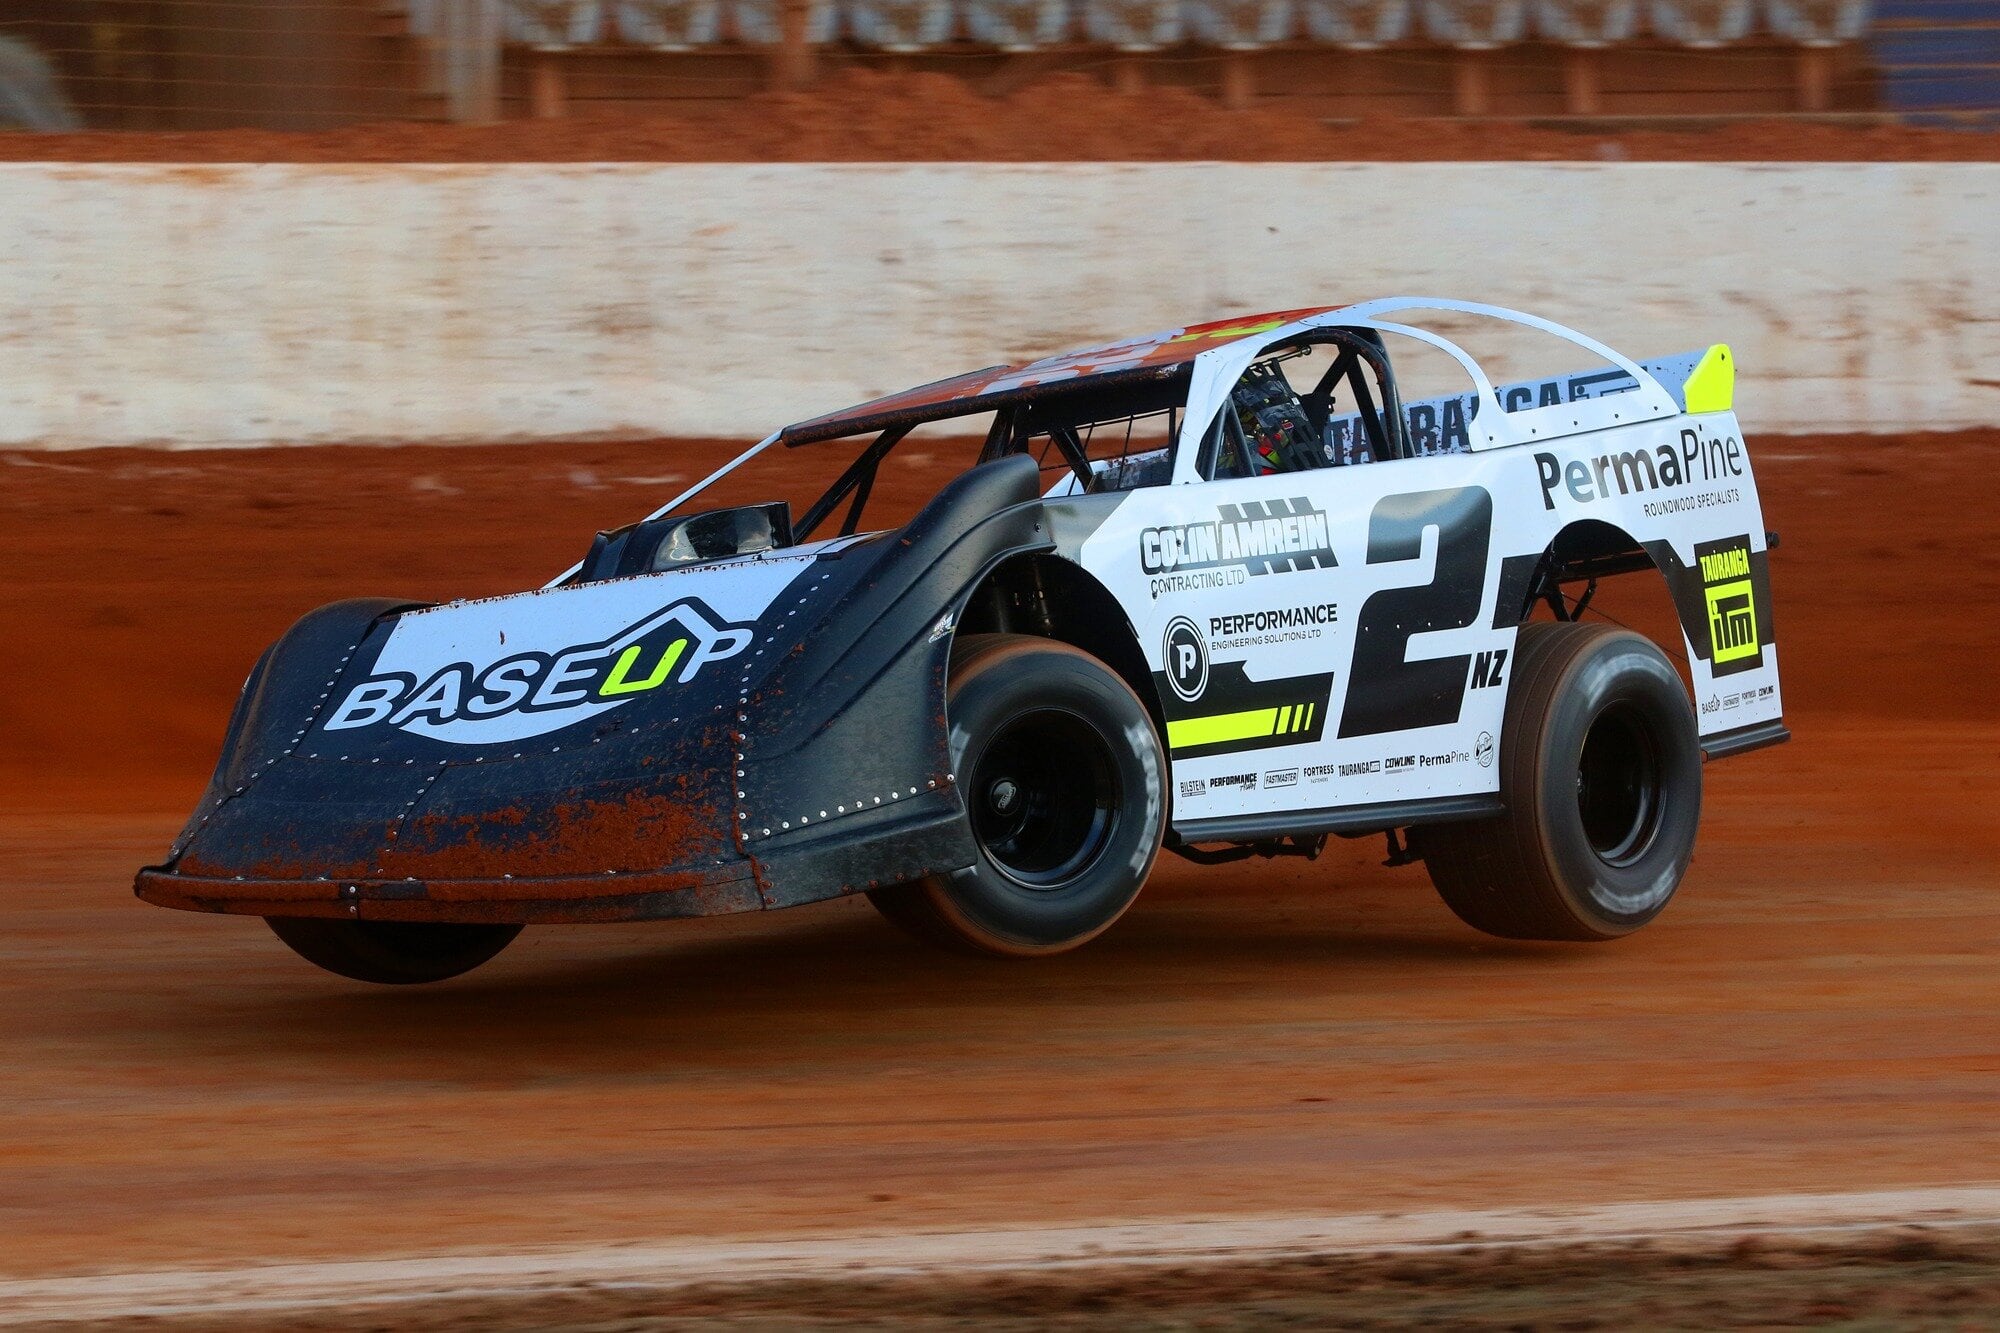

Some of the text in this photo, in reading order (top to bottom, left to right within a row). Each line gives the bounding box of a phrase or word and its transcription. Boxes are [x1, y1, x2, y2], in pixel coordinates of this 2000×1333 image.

[1534, 424, 1743, 511] PermaPine
[1643, 488, 1740, 518] ROUNDWOOD SPECIALISTS
[1141, 513, 1329, 570] COLIN AMREIN
[1700, 548, 1751, 583] TAURANGA
[1150, 569, 1245, 595] CONTRACTING LTD
[1209, 603, 1338, 637] PERFORMANCE
[1336, 485, 1493, 740] 2
[1211, 629, 1321, 651] ENGINEERING SOLUTIONS LTD
[323, 604, 754, 731] BASEUP
[1176, 644, 1197, 679] P
[1470, 649, 1509, 690] NZ
[1303, 764, 1334, 777] FORTRESS
[1338, 761, 1371, 778] TAURANGA
[1385, 755, 1416, 769] COWLING
[1419, 750, 1470, 768] PermaPine
[1180, 779, 1206, 793] BILSTEIN
[1210, 772, 1258, 788] PERFORMANCE
[1265, 772, 1297, 785] FASTMASTER
